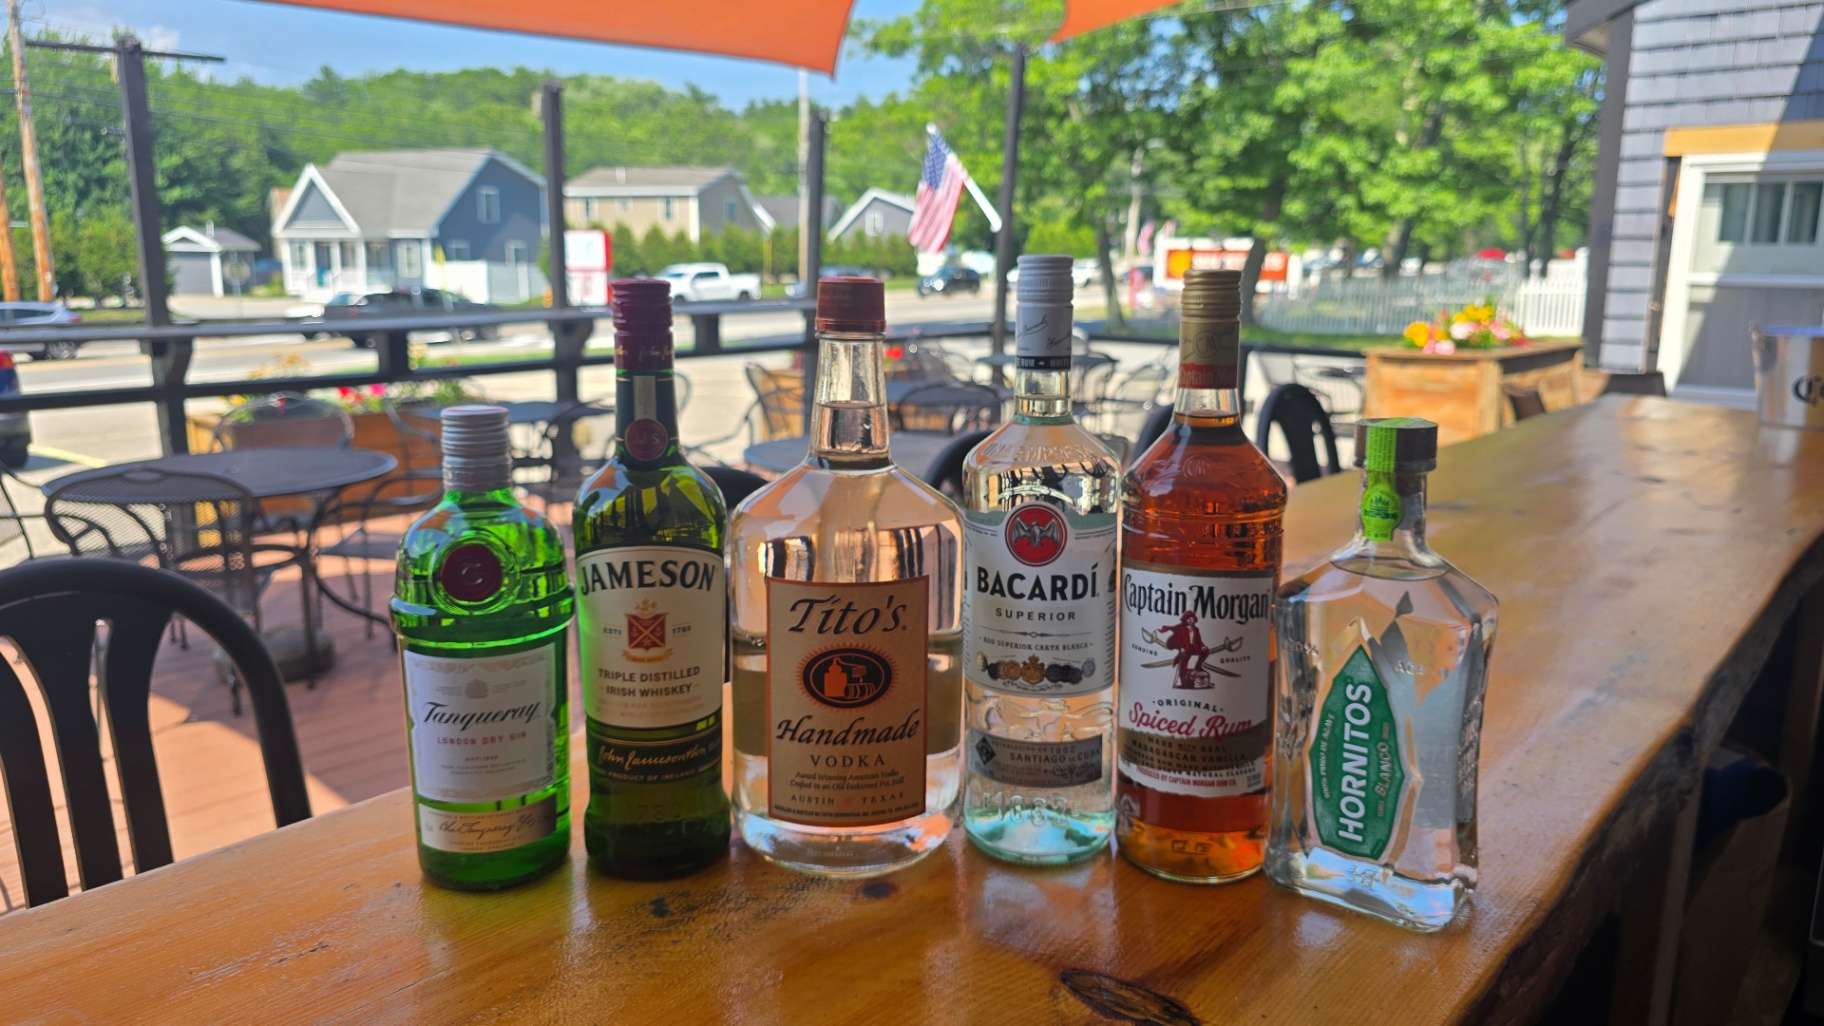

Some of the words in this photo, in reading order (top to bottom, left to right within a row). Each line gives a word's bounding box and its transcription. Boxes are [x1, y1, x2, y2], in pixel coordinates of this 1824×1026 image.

[1180, 368, 1213, 386] aptain
[581, 560, 716, 596] JAMESON
[977, 562, 1099, 601] BACARDÍ
[1124, 573, 1187, 616] Captain
[1188, 585, 1269, 625] Morgan
[788, 594, 907, 635] Tito's
[995, 608, 1077, 622] SUPERIOR
[997, 638, 1033, 650] SUPERIOR
[1034, 644, 1059, 652] CARTA
[1220, 656, 1252, 664] QUALITY
[598, 667, 636, 683] TRIPLE
[640, 665, 701, 683] DISTILLED
[606, 685, 637, 697] IRISH
[640, 682, 693, 698] WHISKEY
[1157, 699, 1218, 713] ORIGINAL
[423, 701, 542, 732] Tanqueray
[1128, 701, 1197, 737] Spiced
[1199, 714, 1252, 741] Rum
[776, 708, 920, 746] Handmade
[437, 736, 477, 745] LONDON
[482, 735, 504, 745] DRY
[1148, 737, 1173, 748] MADE
[1009, 752, 1066, 763] SANTIAGO
[1131, 740, 1197, 762] MADAGASCAR
[1201, 753, 1247, 763] VANILLA
[810, 754, 886, 768] VODKA
[1338, 684, 1373, 843] HORNITOS
[608, 771, 645, 781] PRODUCT
[818, 772, 847, 783] Winning
[848, 772, 880, 780] American
[1374, 741, 1394, 798] BLANCO
[832, 782, 845, 790] Old
[790, 794, 836, 805] AUSTIN
[861, 791, 905, 804] TEXAS
